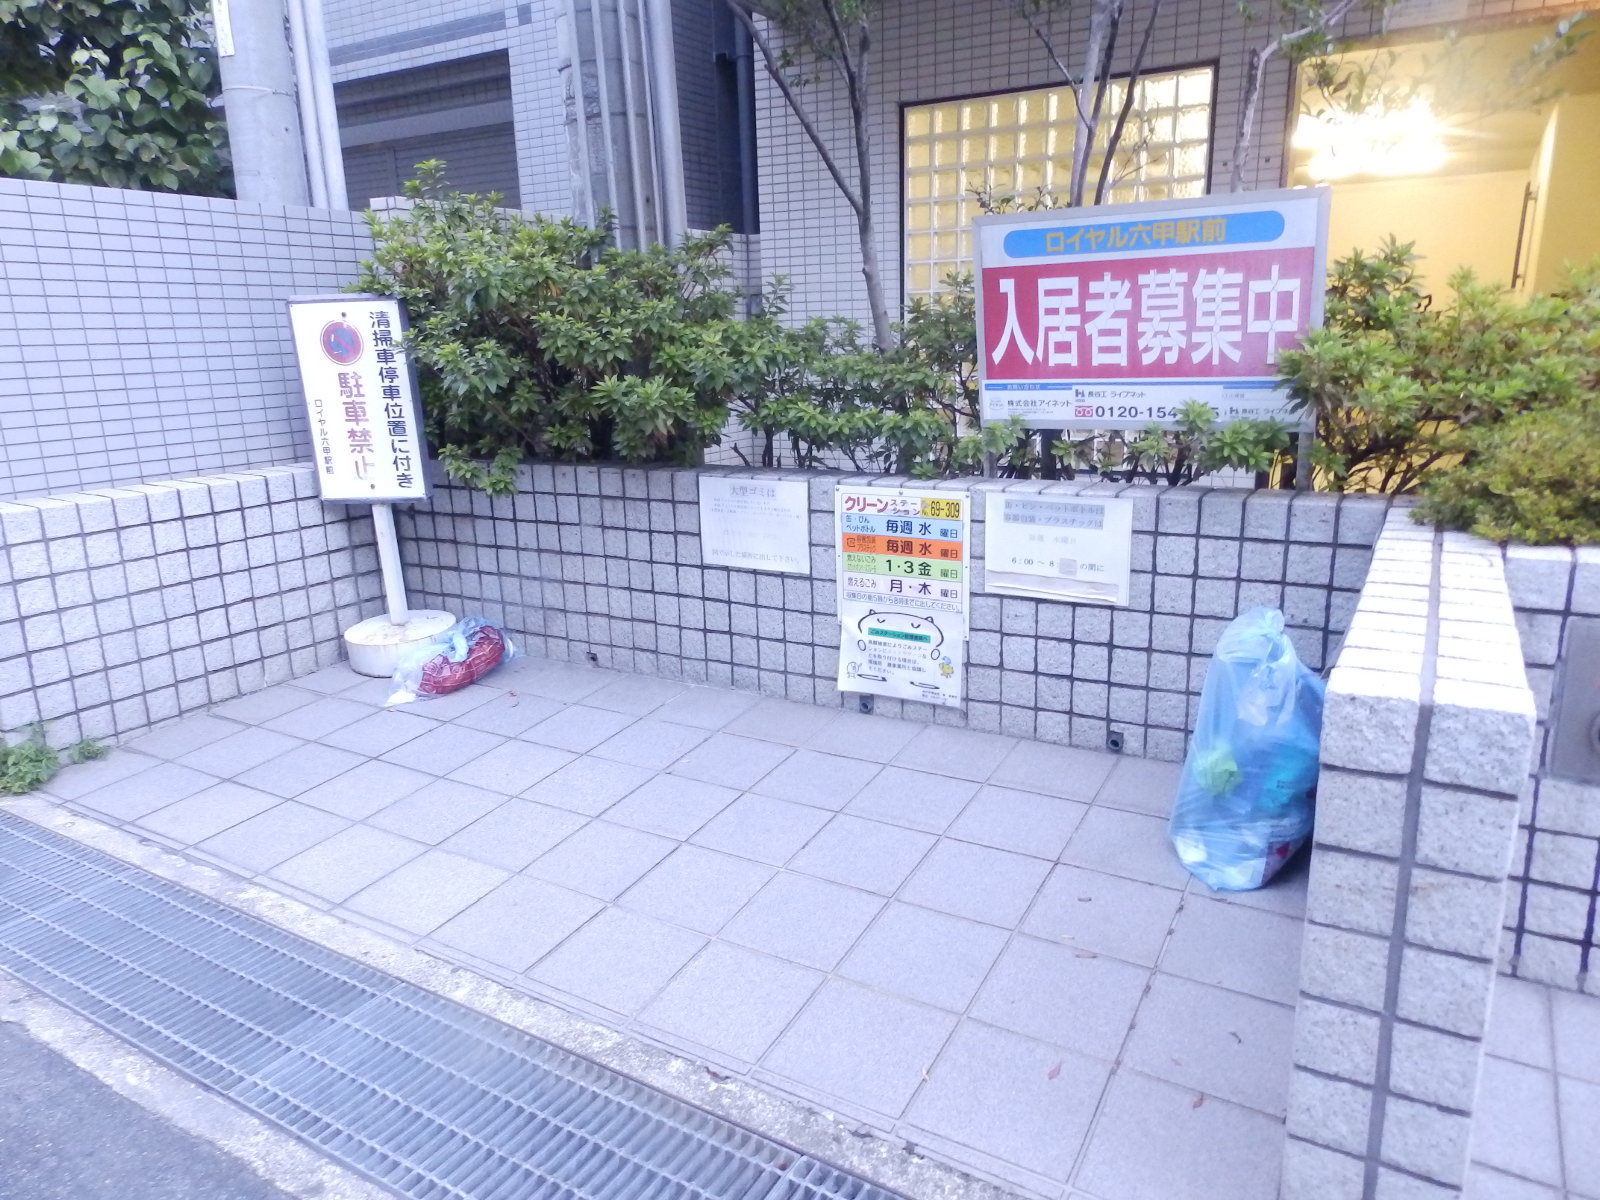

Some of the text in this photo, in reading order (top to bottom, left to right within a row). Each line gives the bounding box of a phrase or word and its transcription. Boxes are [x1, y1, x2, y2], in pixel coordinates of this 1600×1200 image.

[1046, 217, 1226, 252] ロイヤル六甲駅前
[992, 264, 1300, 366] 入居者募集中
[369, 311, 413, 488] 清掃車停車位置に付き
[338, 371, 375, 481] 駐車禁止
[315, 399, 334, 475] ロイヤル六甲駅前
[845, 496, 889, 513] クリーン
[930, 501, 960, 518] 69-309
[886, 519, 958, 538] 毎週 水 曜日
[887, 539, 958, 559] 毎週 水 曜日
[918, 562, 932, 577] 金
[940, 569, 958, 579] 曜日
[940, 589, 958, 599] 曜日
